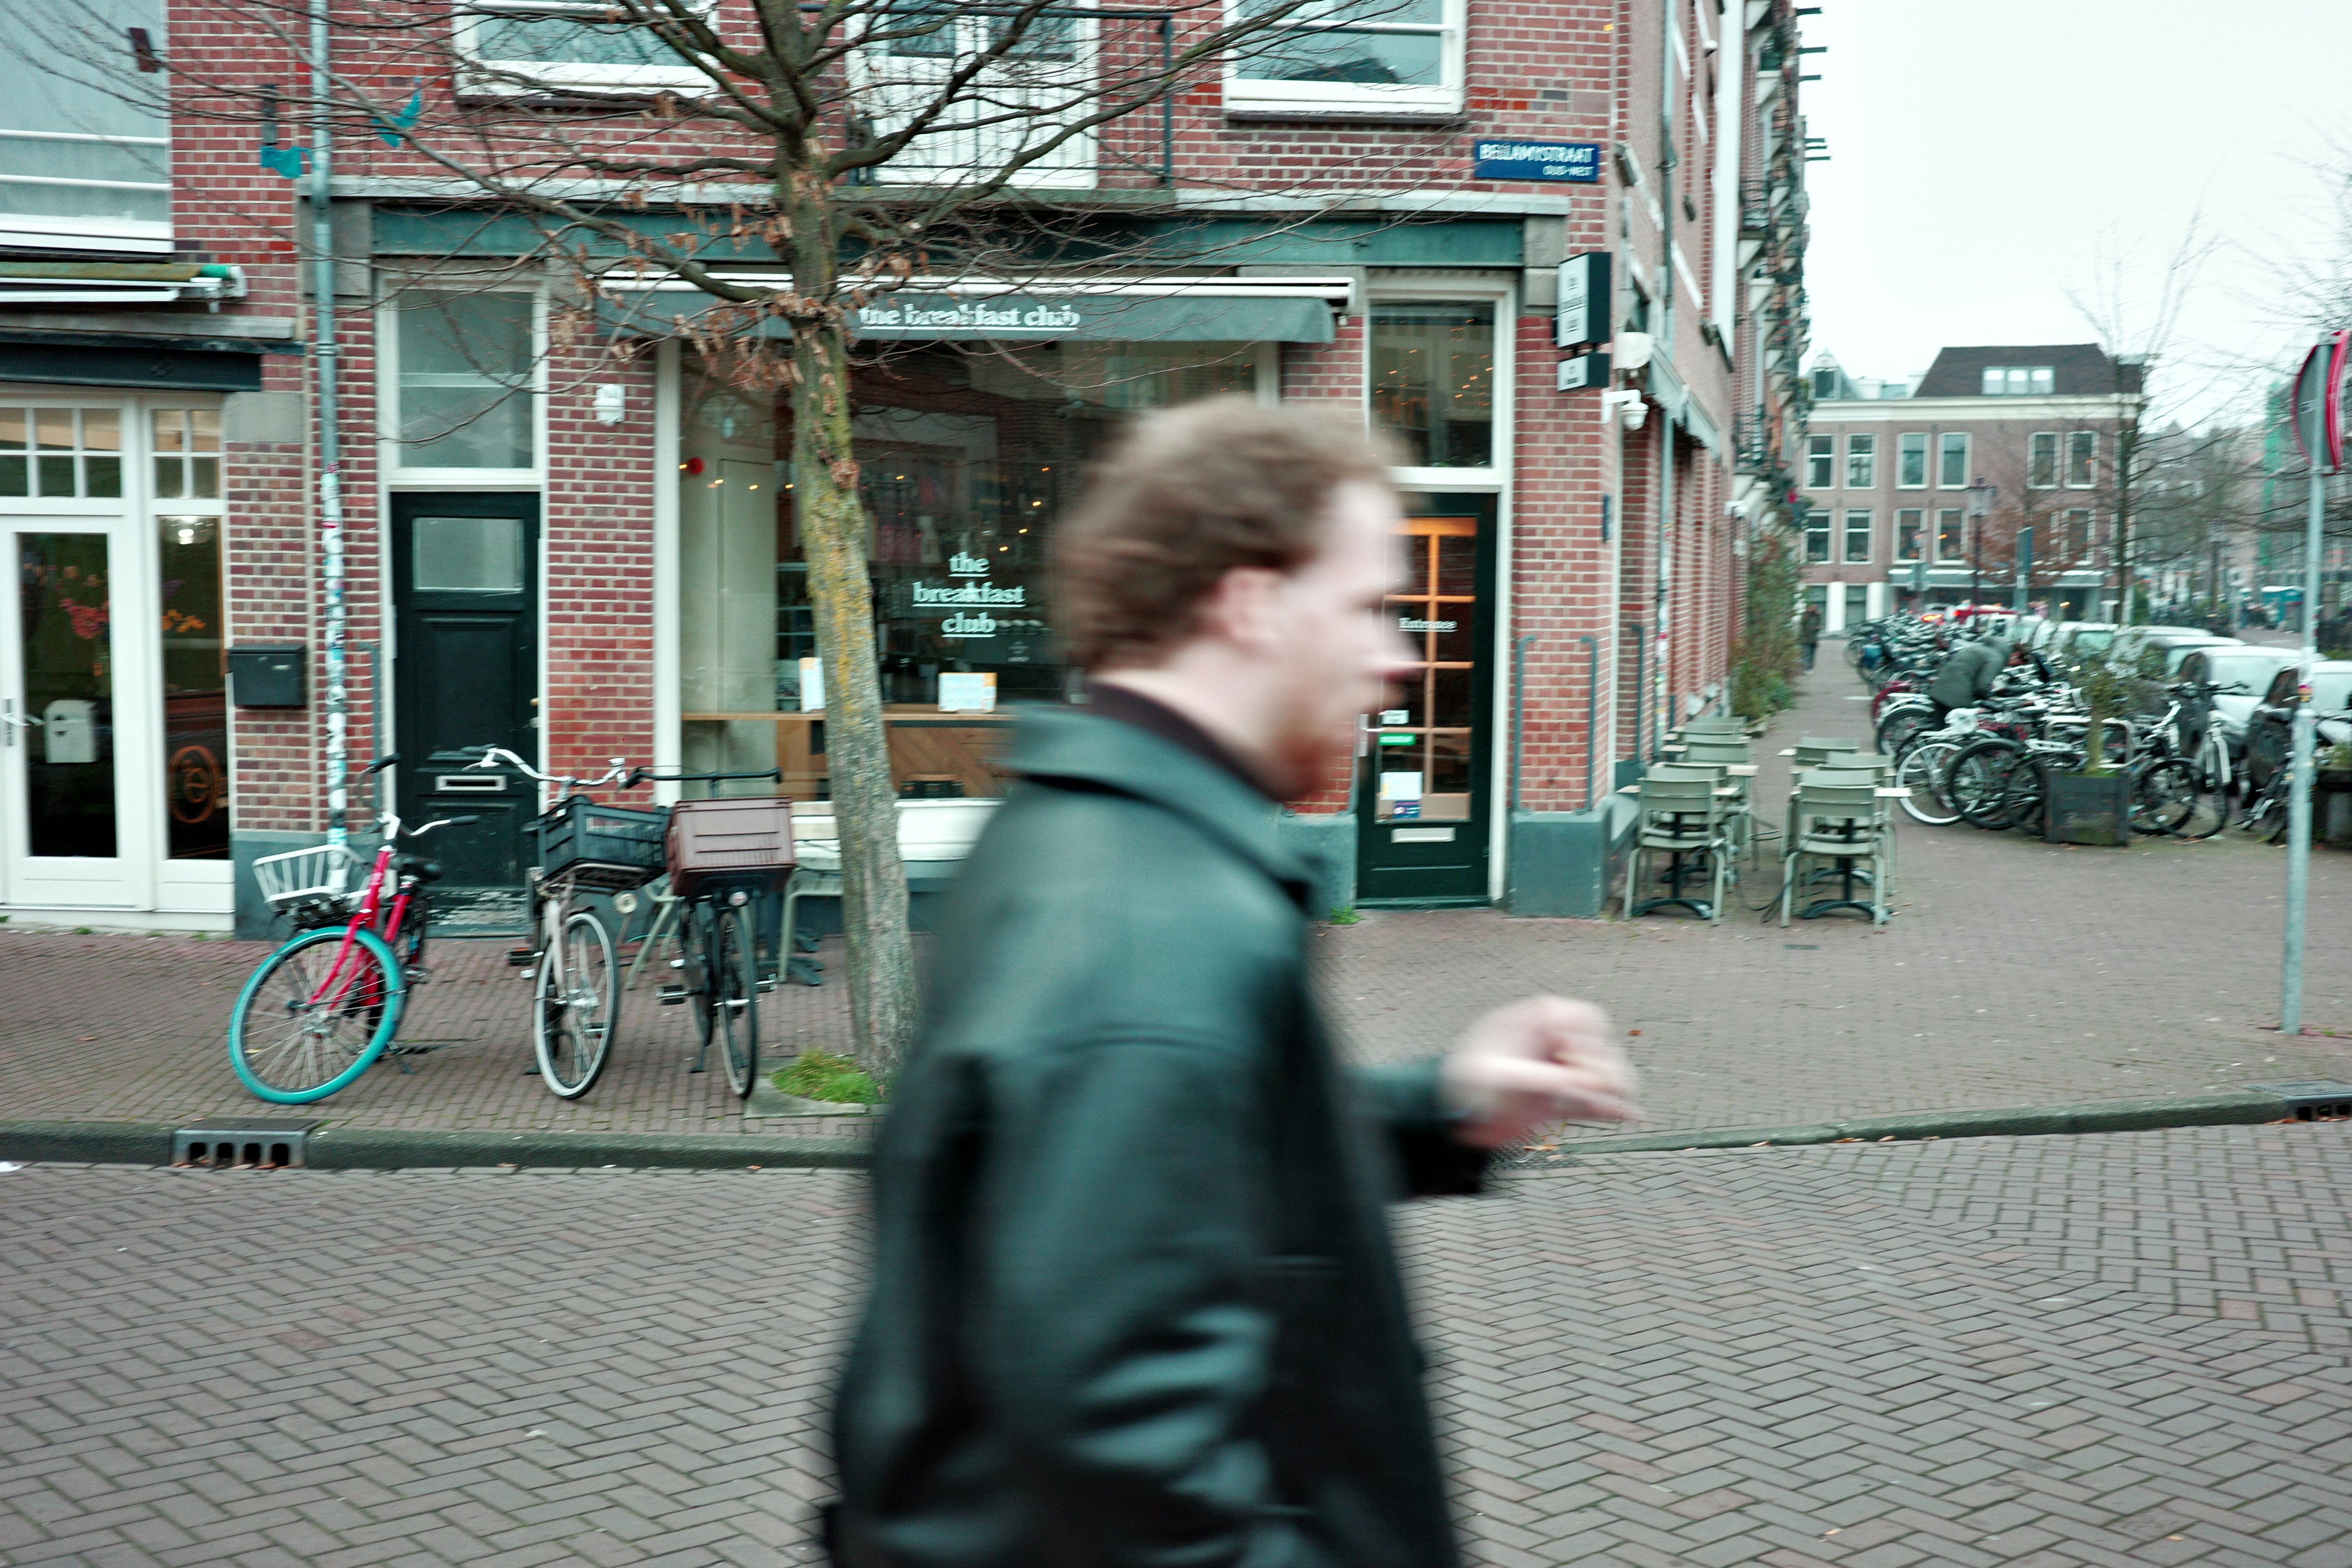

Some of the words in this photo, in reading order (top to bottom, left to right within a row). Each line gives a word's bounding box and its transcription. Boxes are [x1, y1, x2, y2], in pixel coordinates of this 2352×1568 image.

[1479, 144, 1595, 163] BELLAMYSTRAAT
[1543, 165, 1594, 176] OUD-WEST
[858, 303, 901, 325] the
[903, 303, 1022, 326] breakfast
[1024, 304, 1081, 326] club
[948, 551, 990, 573] the
[912, 580, 1026, 603] breakfast
[941, 611, 996, 633] club
